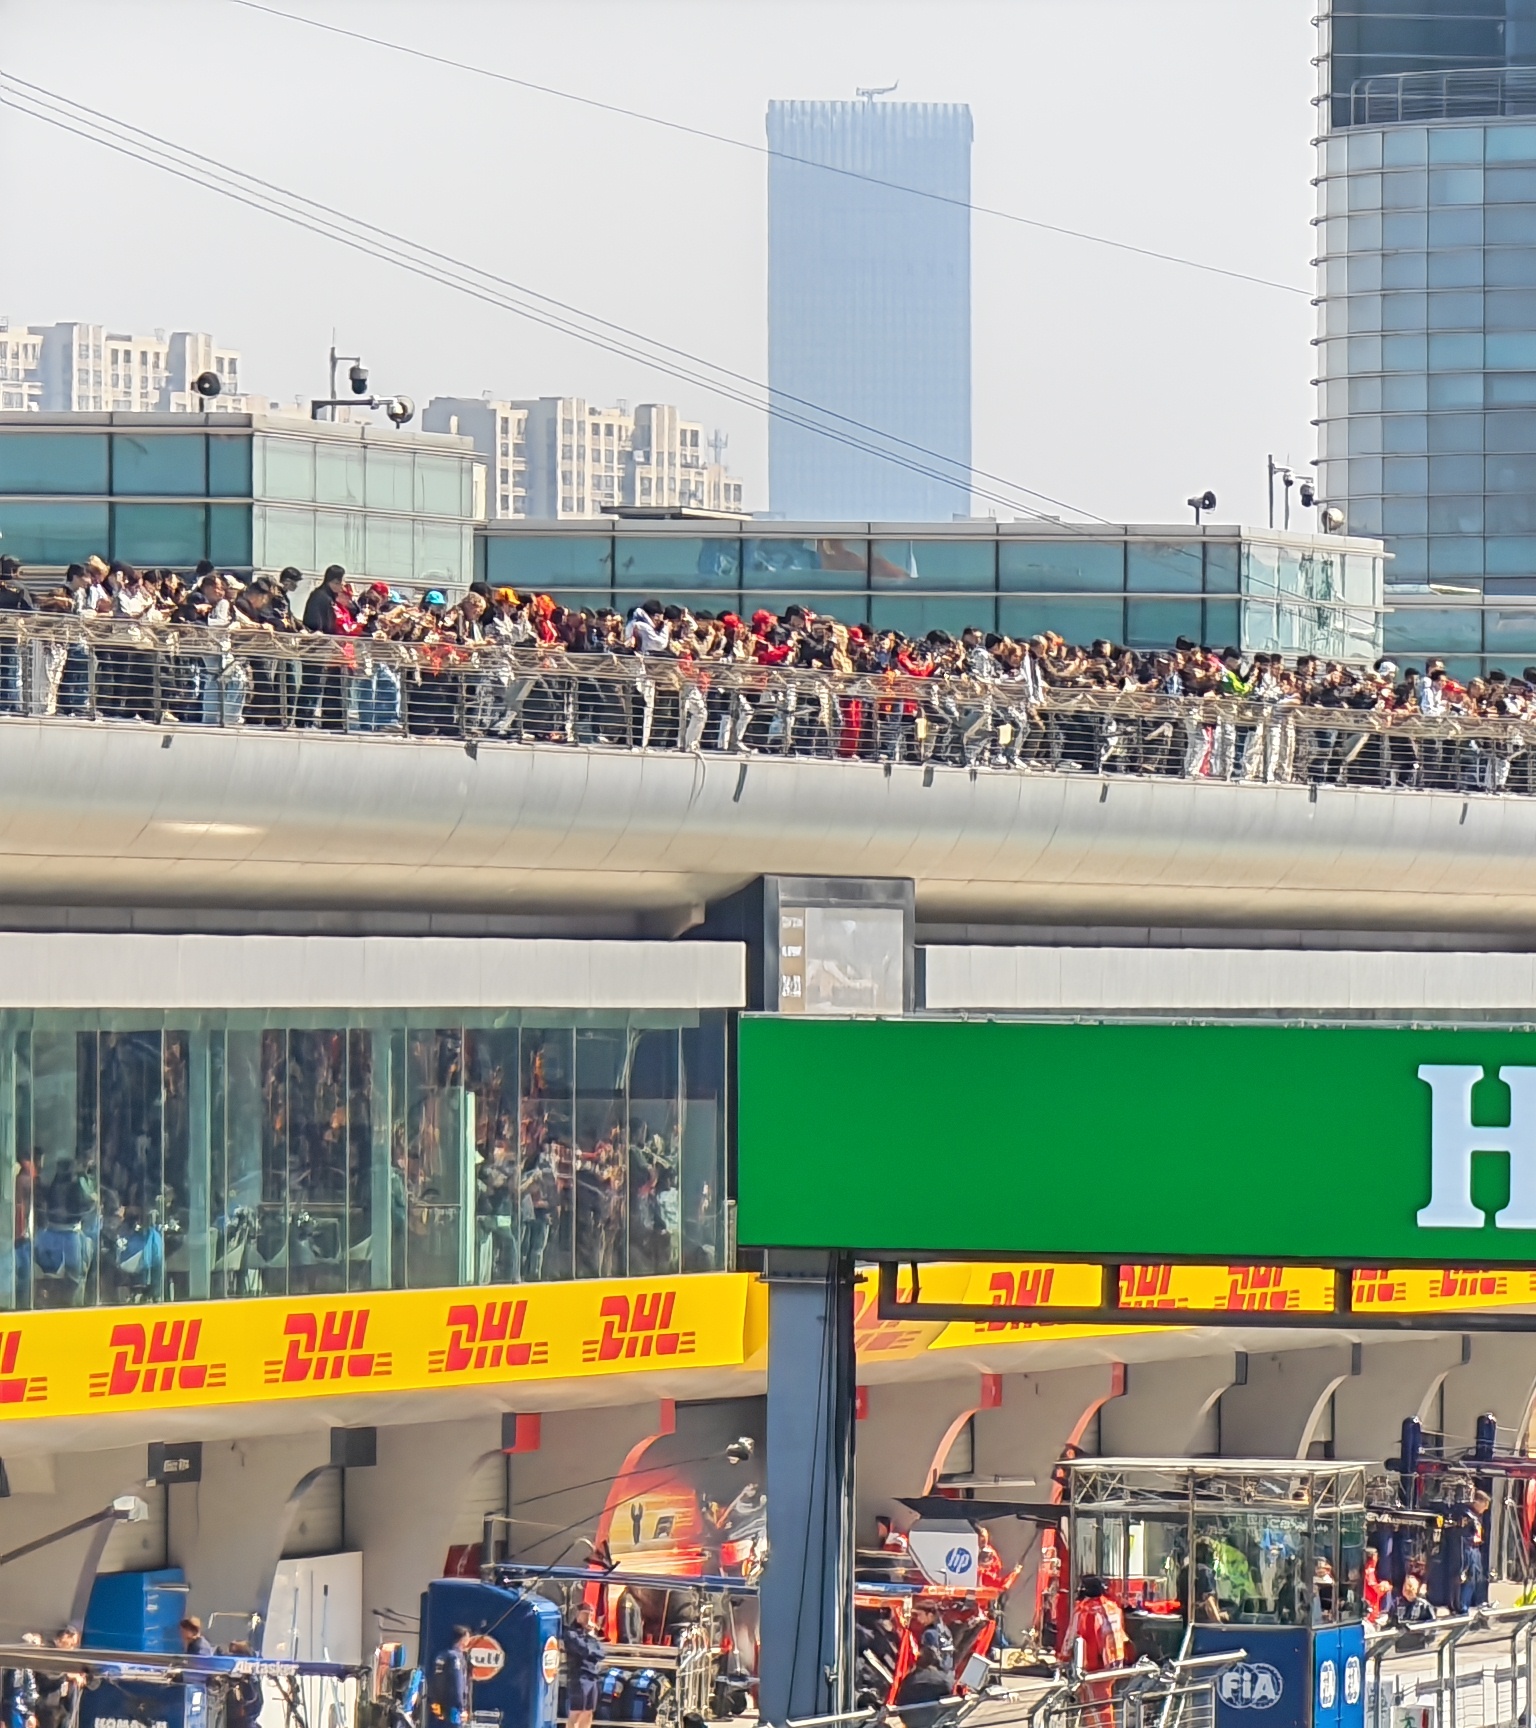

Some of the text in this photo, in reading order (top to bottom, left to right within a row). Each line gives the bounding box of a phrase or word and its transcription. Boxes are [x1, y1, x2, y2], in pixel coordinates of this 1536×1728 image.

[108, 1318, 208, 1397] DHL
[281, 1309, 377, 1384] DHL
[444, 1300, 532, 1372] DHL
[597, 1291, 681, 1361] DHL
[947, 1547, 972, 1574] hp
